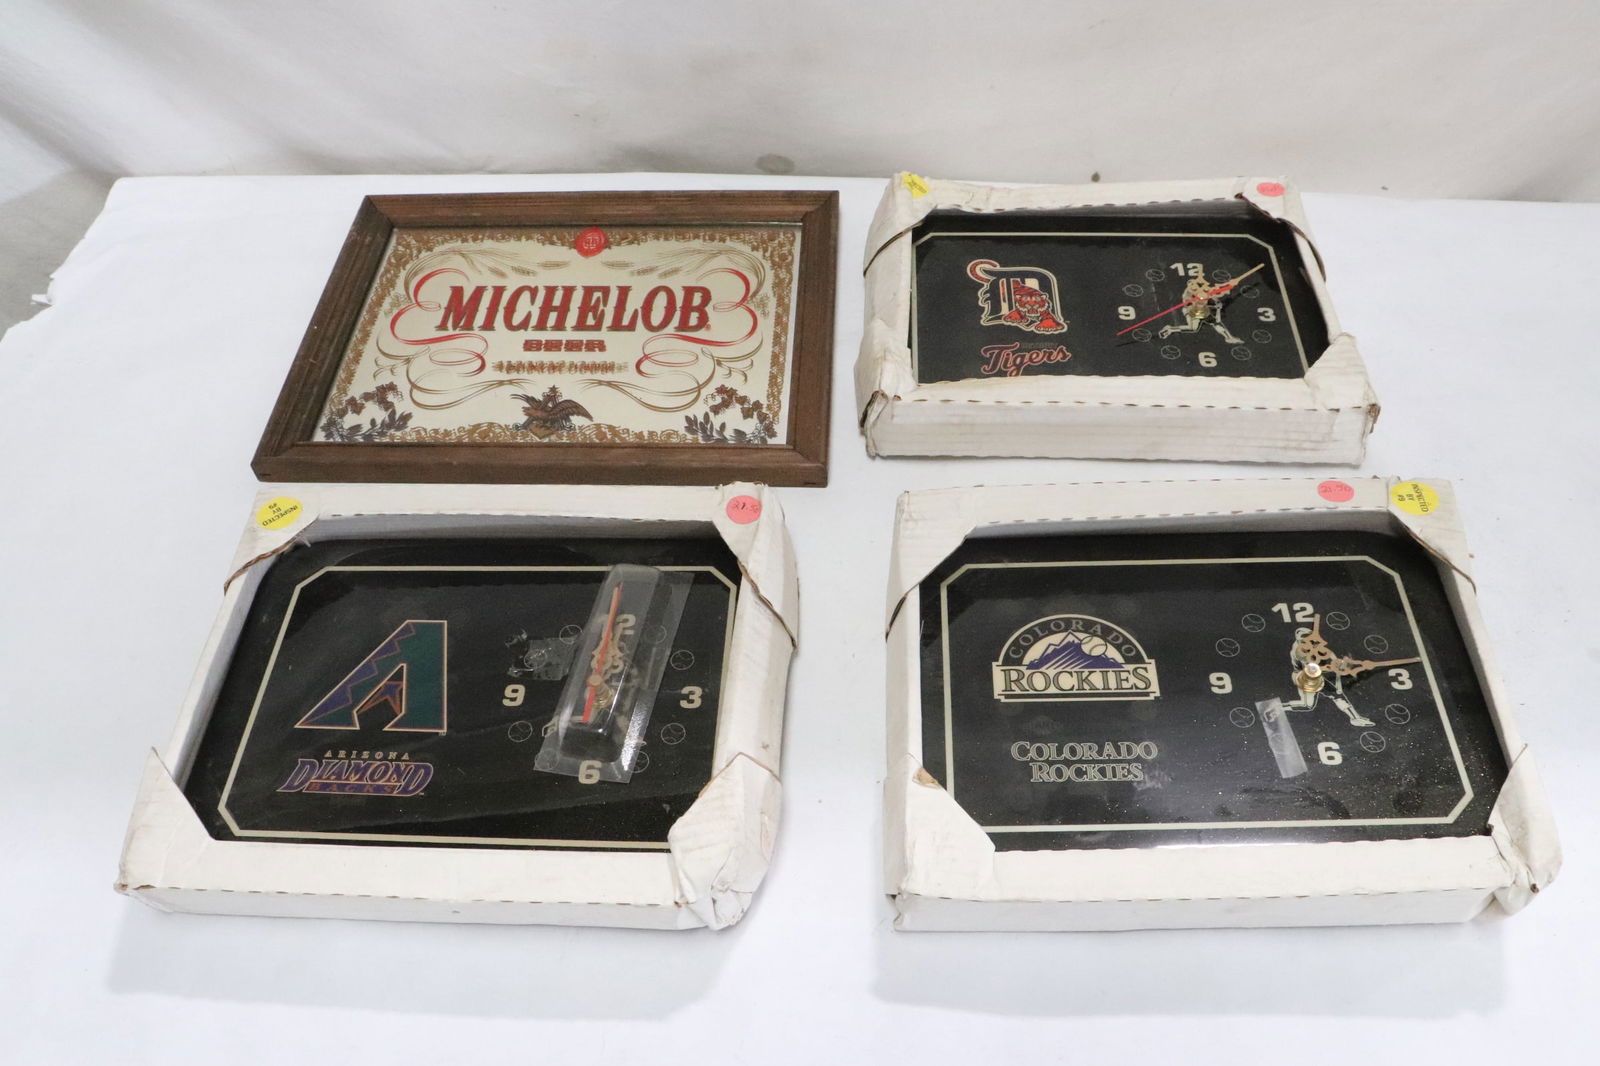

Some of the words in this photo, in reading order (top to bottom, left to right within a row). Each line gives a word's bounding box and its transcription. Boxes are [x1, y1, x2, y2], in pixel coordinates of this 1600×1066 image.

[1170, 262, 1205, 276] 12
[435, 285, 712, 332] MICHELOB
[1117, 305, 1137, 320] 9
[1256, 307, 1276, 322] 3
[523, 339, 606, 352] BEER
[981, 342, 1072, 377] Tigers
[1197, 351, 1217, 367] 6
[1271, 602, 1315, 623] 12
[1009, 619, 1136, 659] COLORADO
[1001, 666, 1152, 692] ROCKIES
[1208, 671, 1233, 694] 9
[1387, 668, 1413, 690] 3
[502, 684, 526, 707] 9
[679, 685, 703, 709] 3
[324, 750, 410, 760] ARIZONA
[1010, 741, 1158, 761] COLORADO
[1316, 741, 1343, 766] 6
[276, 758, 434, 797] DIAMOND
[578, 760, 602, 785] 6
[1029, 762, 1144, 782] ROCKIES
[308, 783, 394, 793] BACKS
